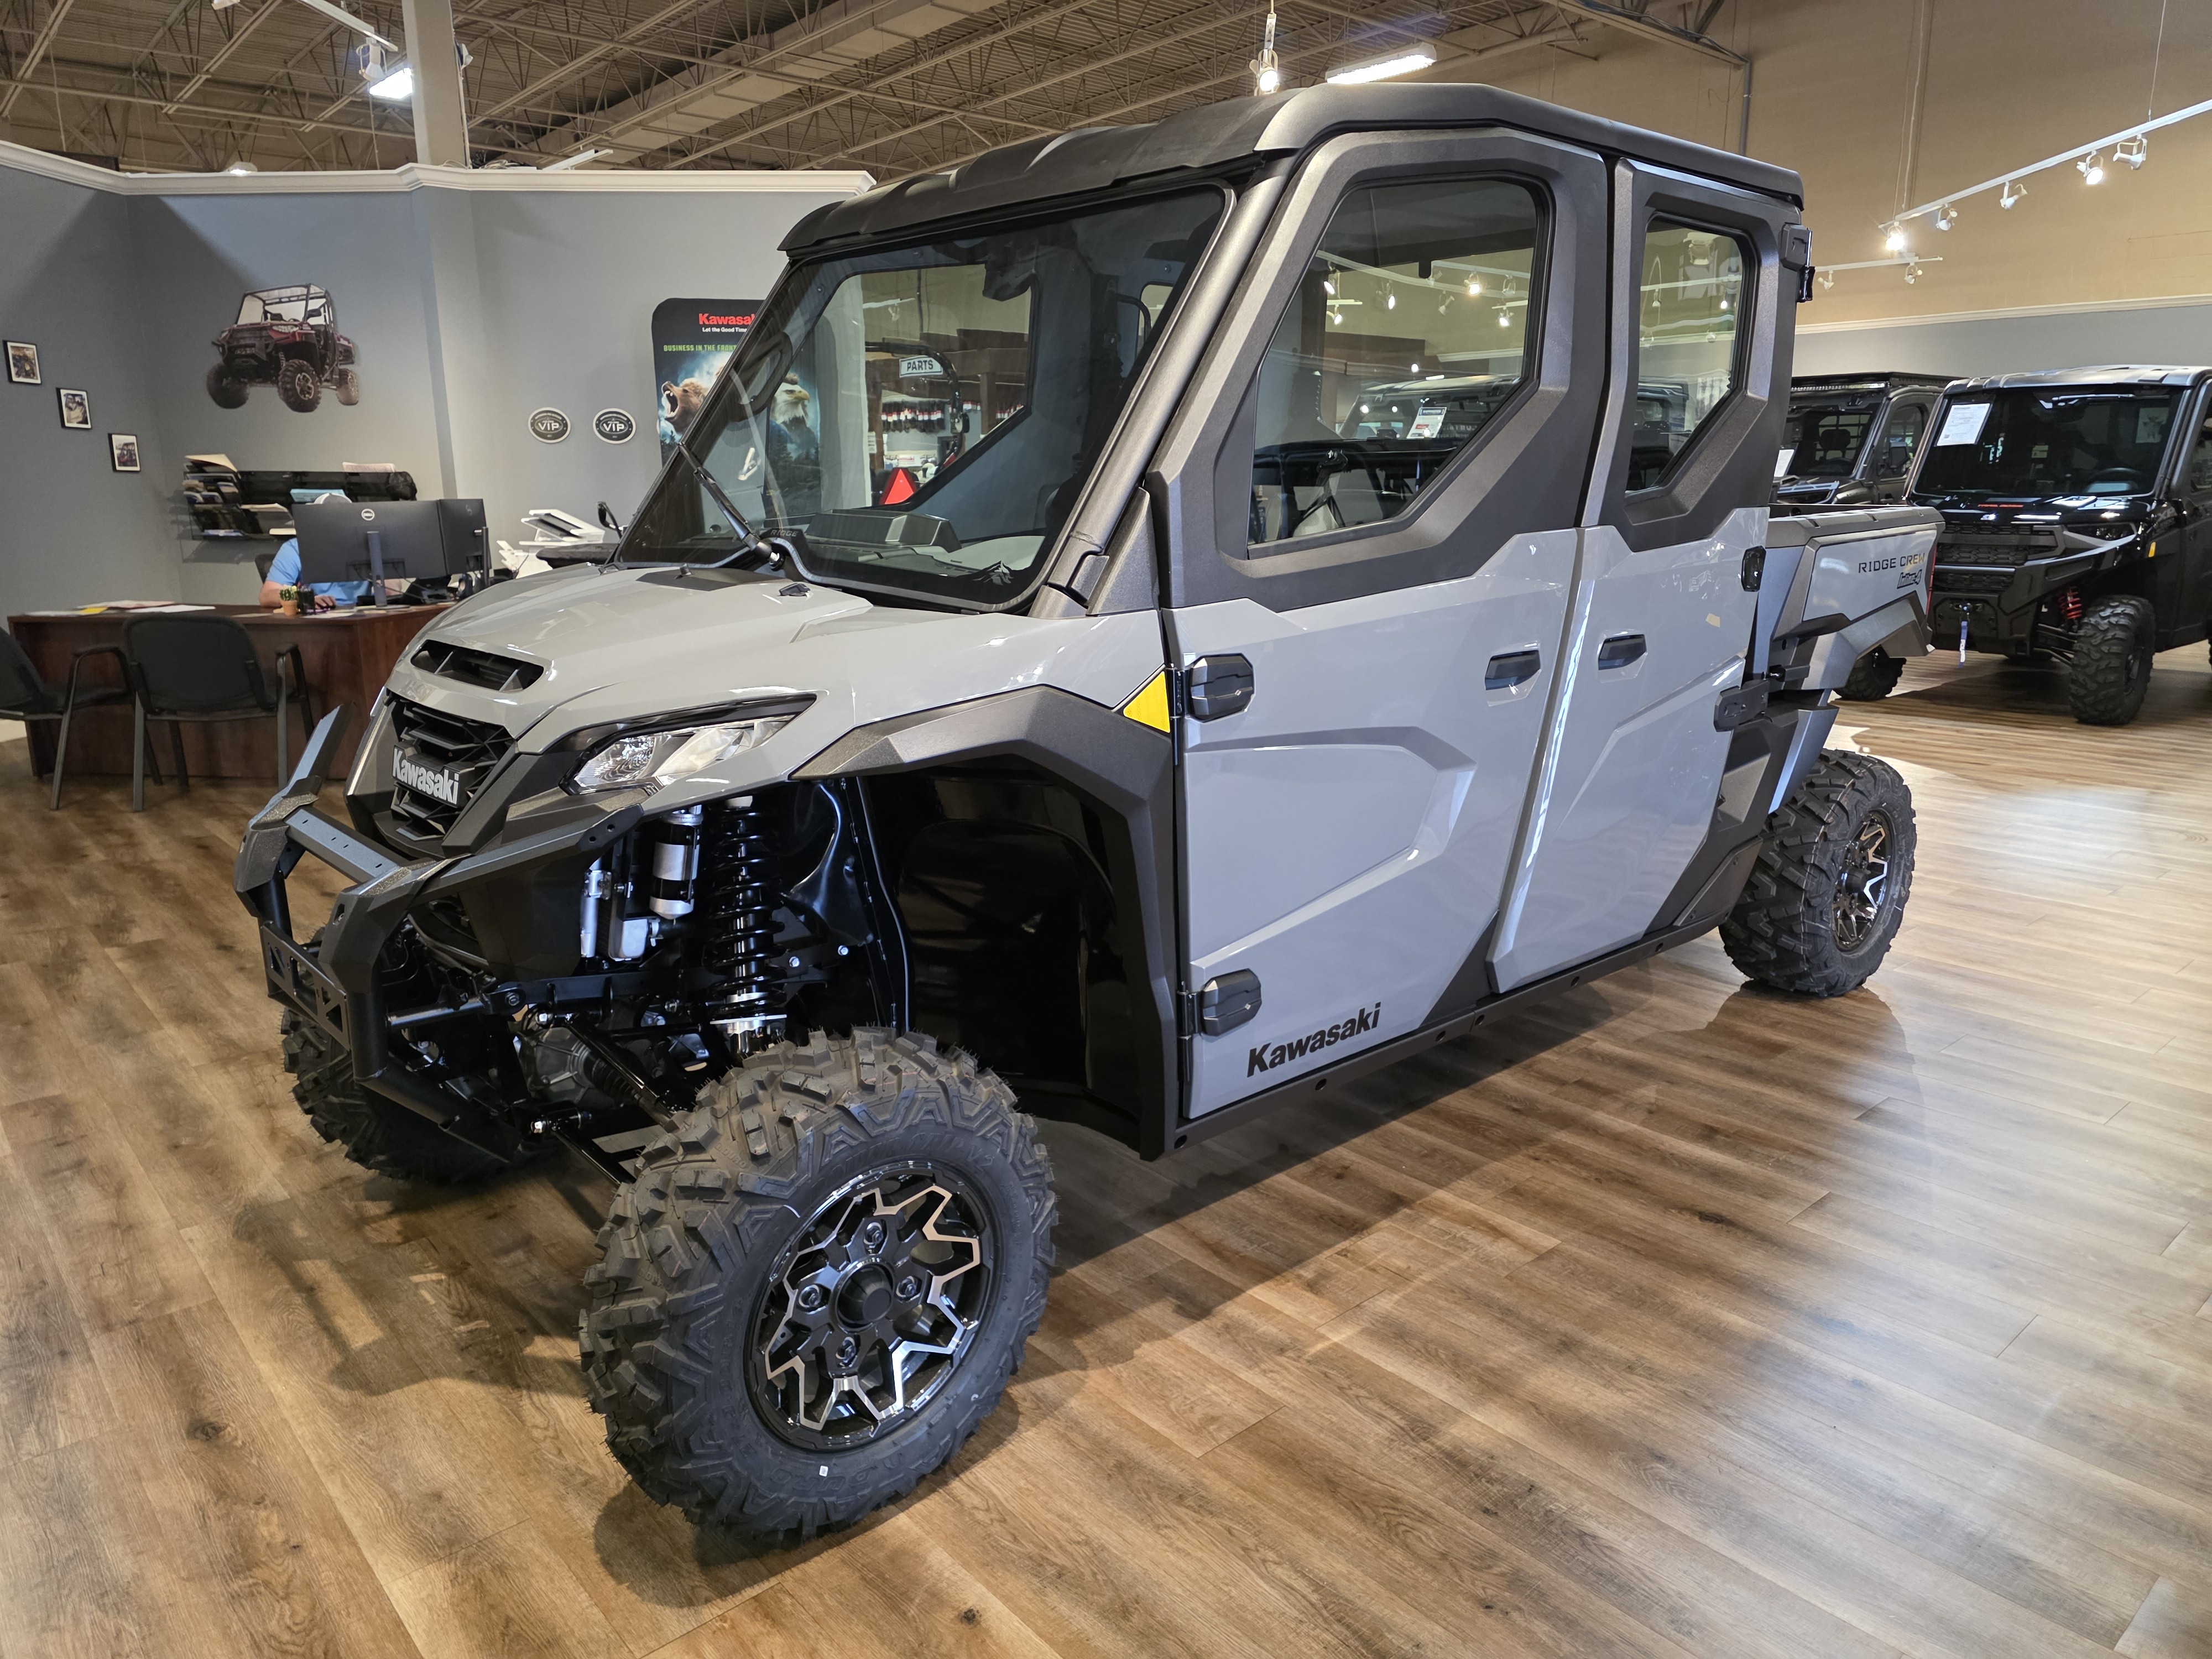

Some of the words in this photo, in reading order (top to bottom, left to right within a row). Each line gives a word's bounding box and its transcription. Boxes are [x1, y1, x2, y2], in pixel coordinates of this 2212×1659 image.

[907, 359, 933, 371] PARTS
[603, 423, 624, 431] VIP
[1859, 558, 1896, 573] RIDGE
[1900, 553, 1925, 567] CREW
[393, 748, 459, 805] Kawasaki
[1247, 1001, 1381, 1078] Kawasaki
